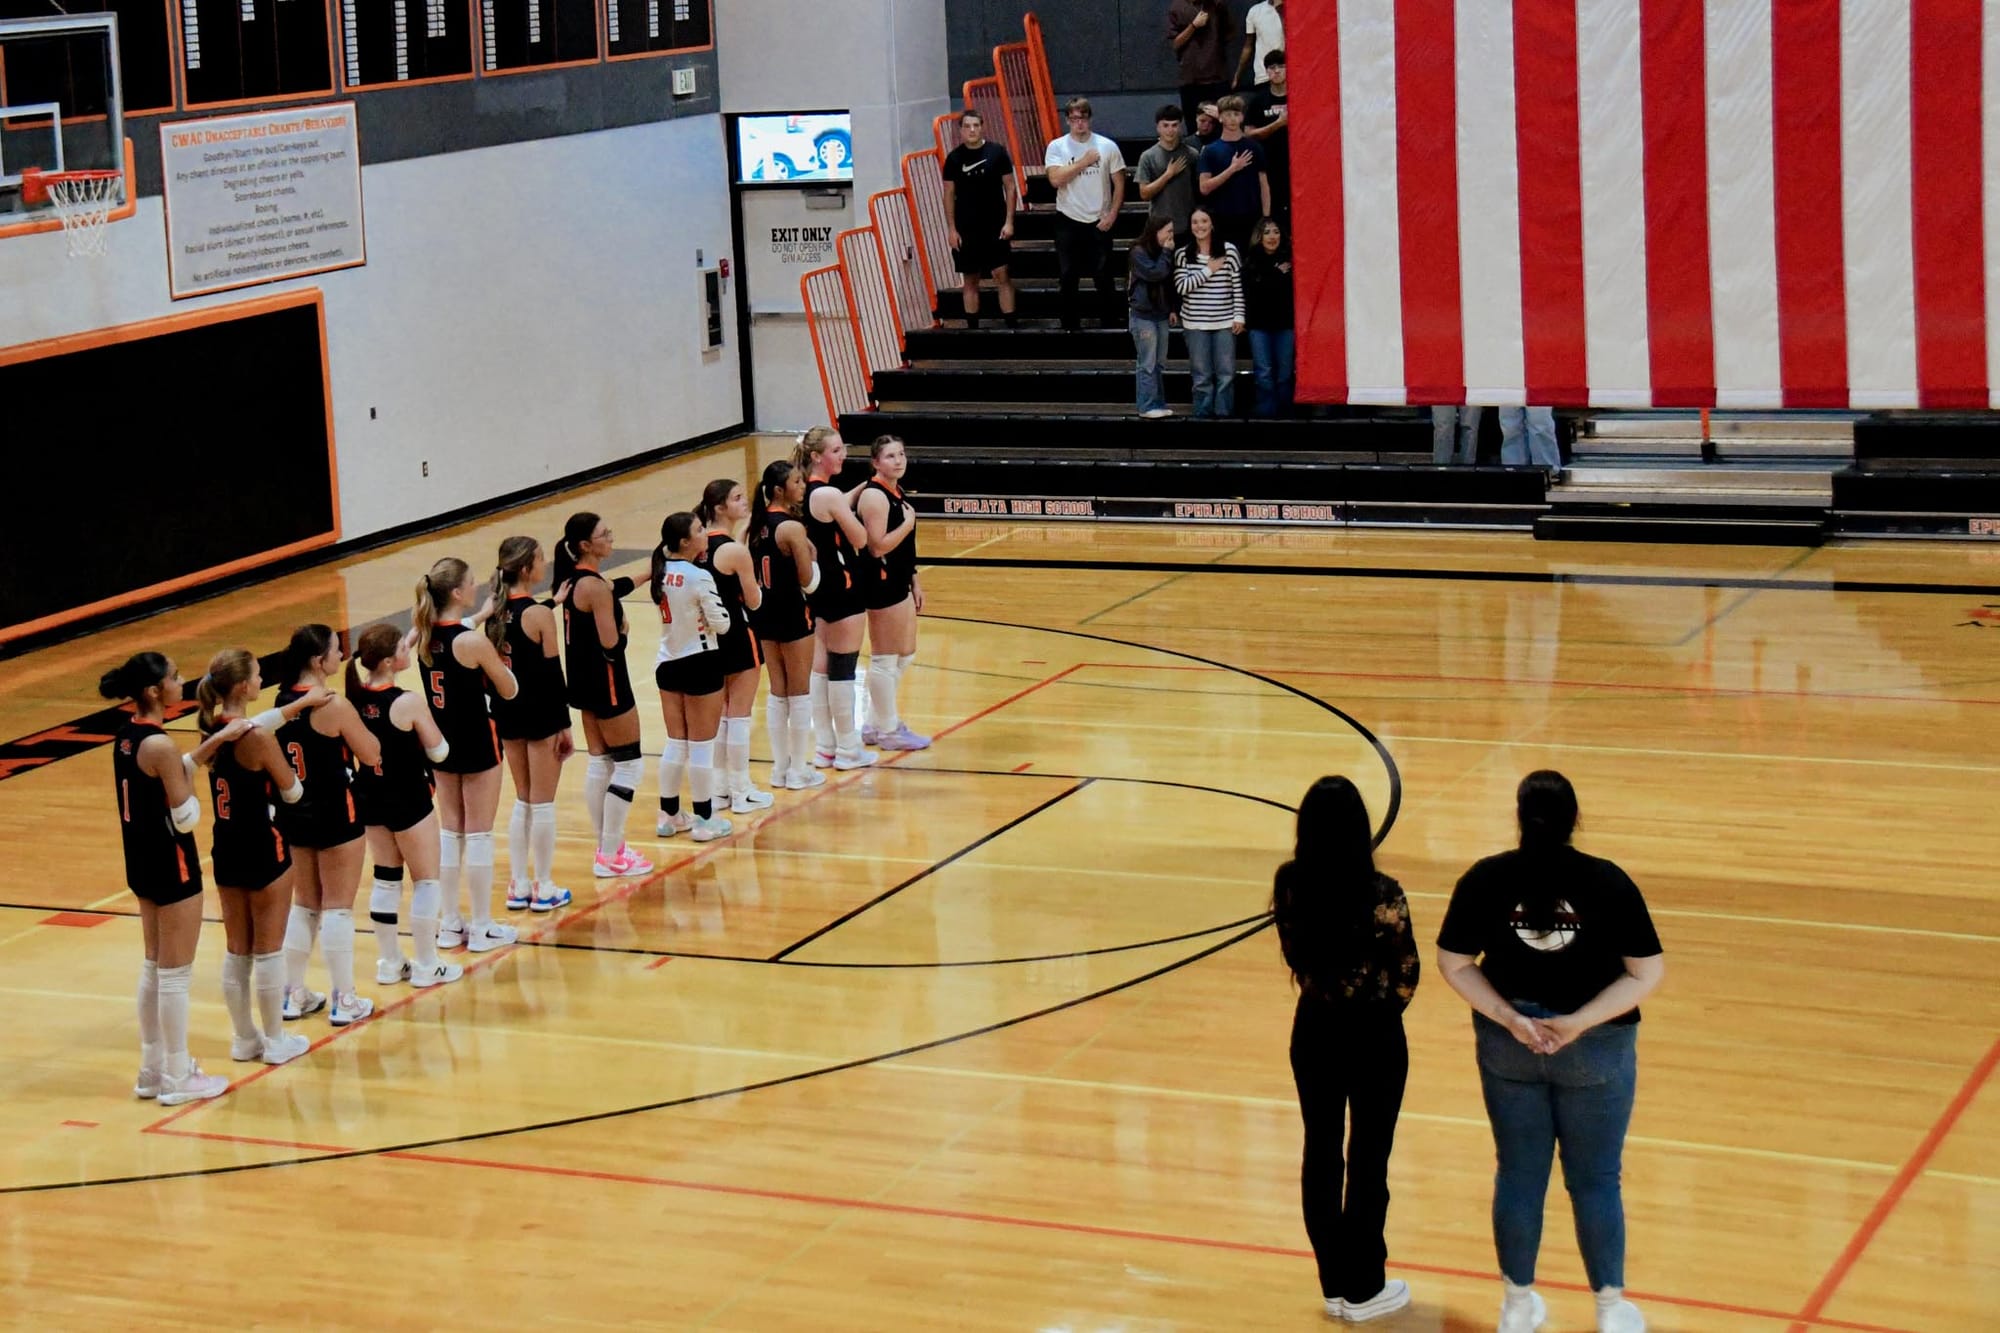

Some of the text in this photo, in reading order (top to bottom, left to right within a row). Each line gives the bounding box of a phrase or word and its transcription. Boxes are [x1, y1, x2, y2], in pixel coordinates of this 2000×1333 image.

[172, 132, 202, 147] CWAC
[771, 226, 832, 242] EXIT ONLY
[771, 242, 833, 253] DO NOT OPEN FOR
[781, 252, 822, 264] GYM ACCESS
[944, 498, 1095, 516] EPHRATA HIGH SCHOOL
[1175, 503, 1336, 521] EPHRATA HIGH SCHOOL
[430, 670, 445, 709] 5
[287, 741, 307, 782] 3
[122, 778, 131, 823] 1
[216, 777, 231, 819] 2
